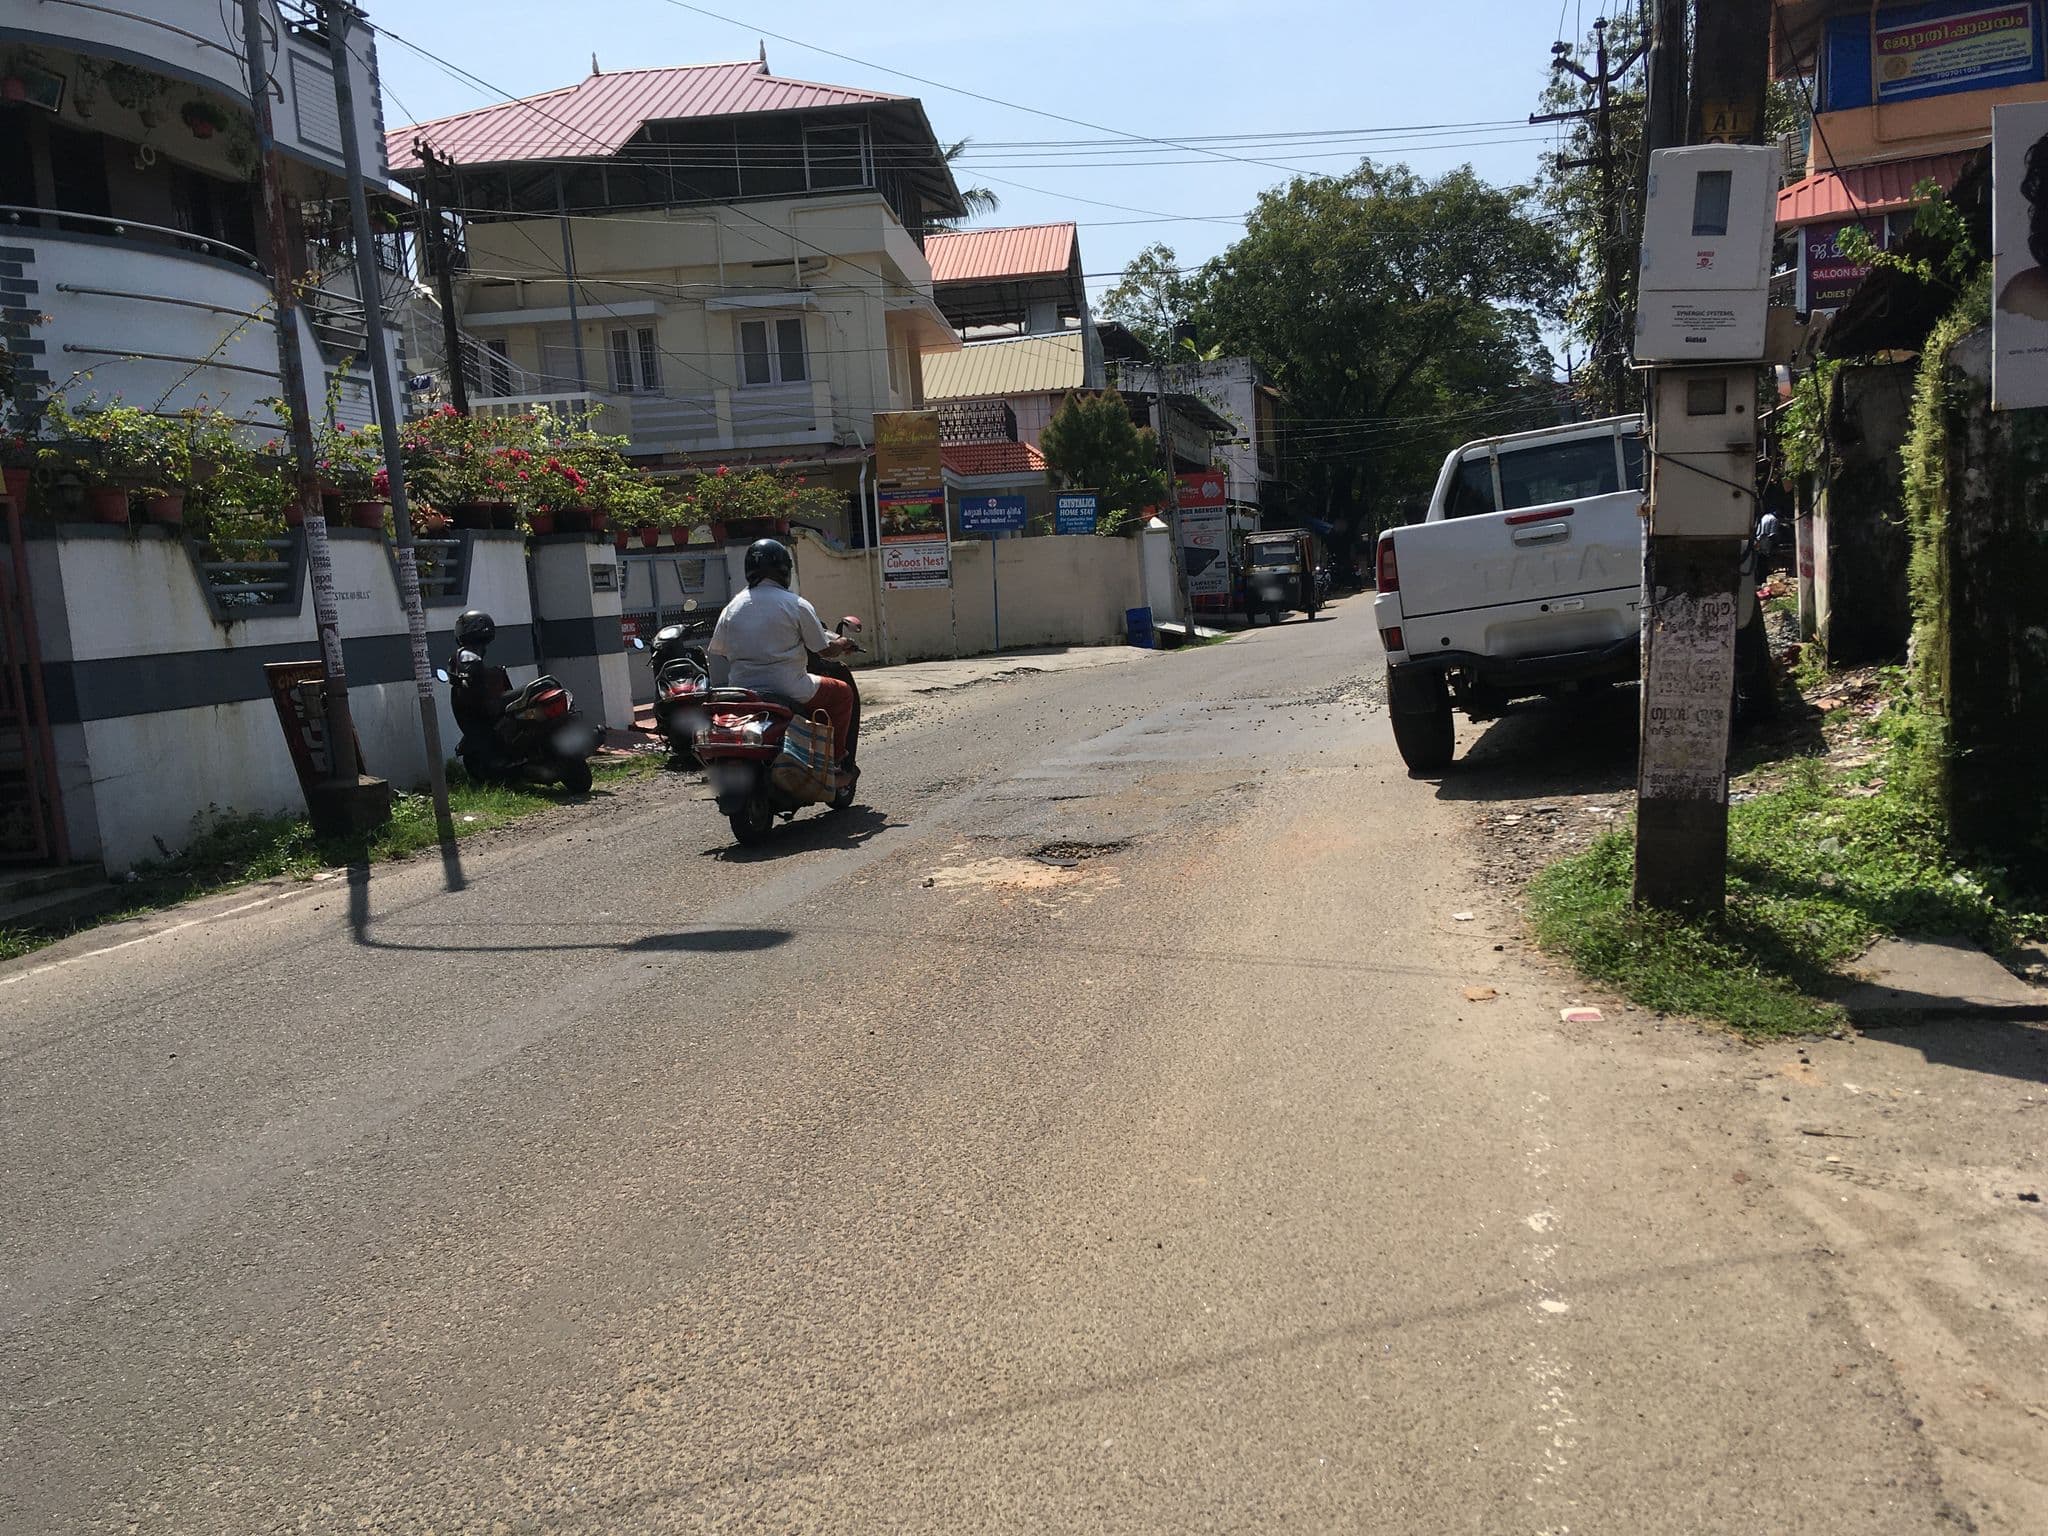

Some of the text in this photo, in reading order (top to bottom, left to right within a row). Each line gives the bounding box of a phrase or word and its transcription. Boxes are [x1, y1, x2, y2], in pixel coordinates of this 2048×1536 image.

[1812, 268, 1850, 279] SALOON
[1851, 268, 1859, 277] &
[1815, 290, 1846, 300] LADIES
[1059, 508, 1079, 517] HOME
[887, 556, 945, 568] Cukoos Nest
